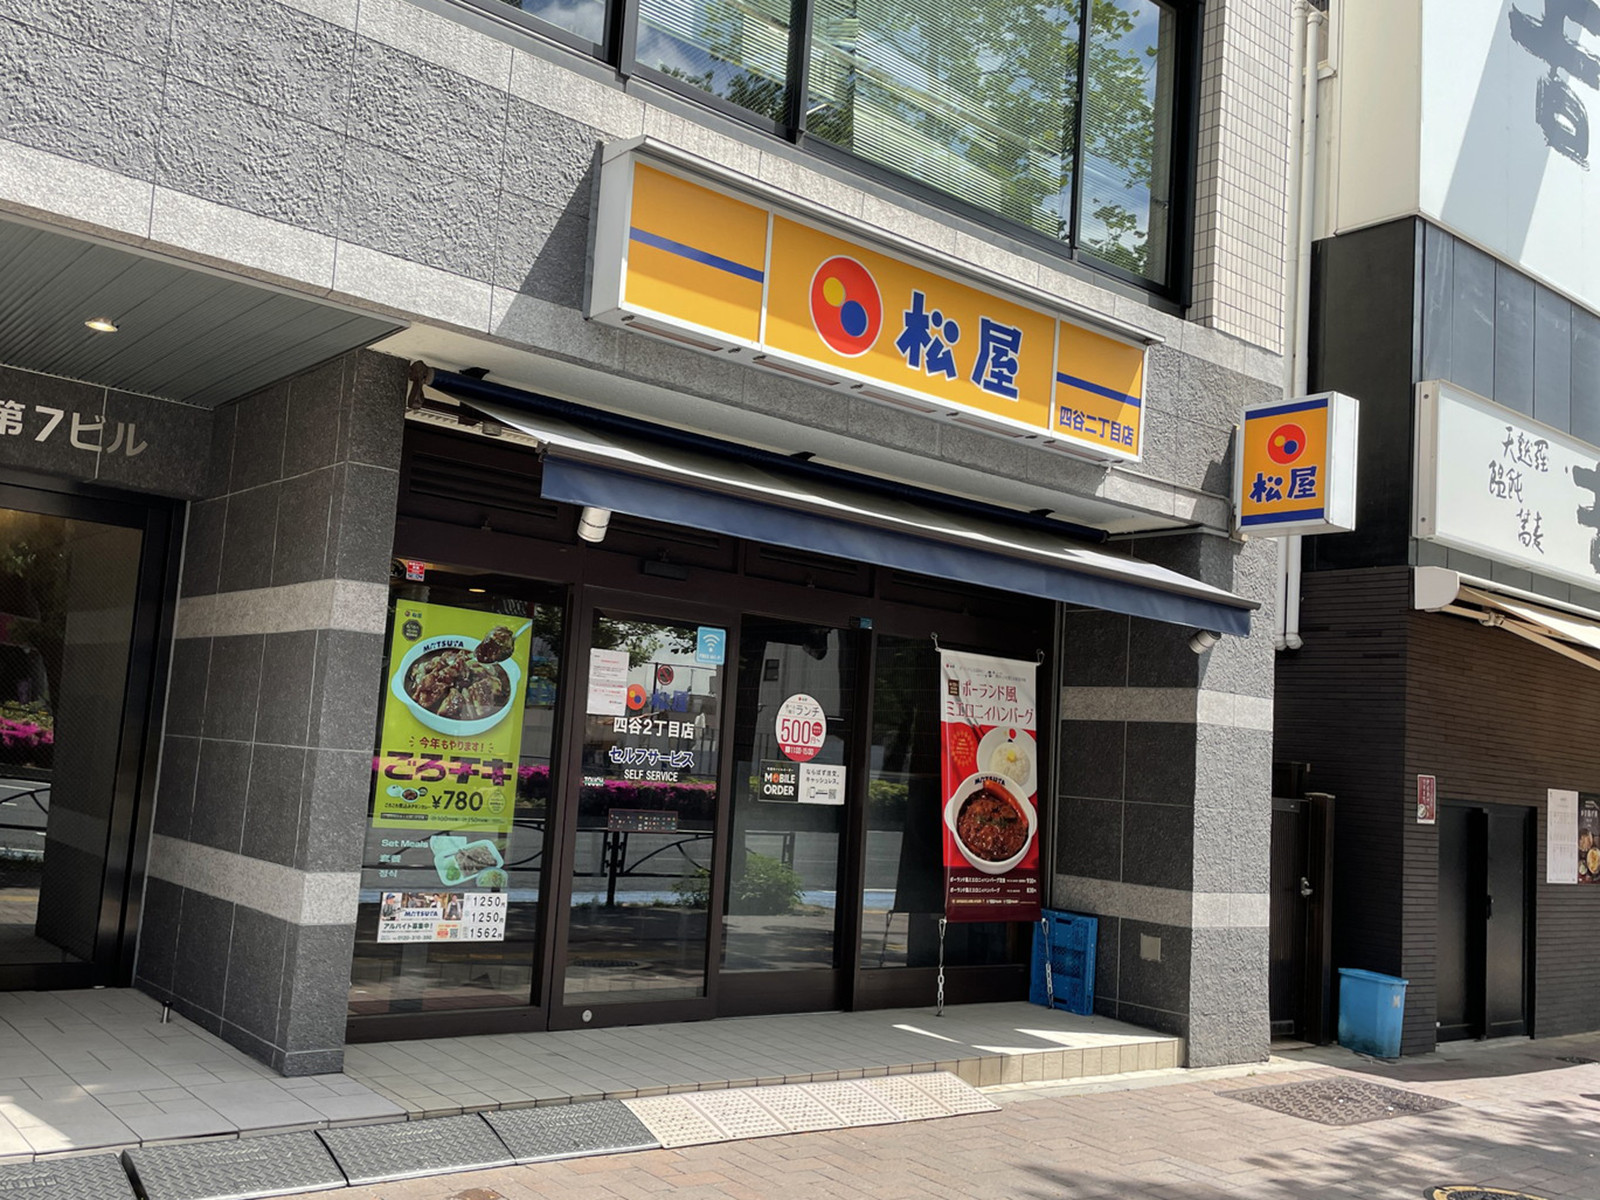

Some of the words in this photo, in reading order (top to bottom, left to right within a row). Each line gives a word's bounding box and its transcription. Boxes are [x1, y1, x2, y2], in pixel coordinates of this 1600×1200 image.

[895, 288, 1023, 402] 松屋
[0, 400, 148, 457] 第7ビル
[1060, 405, 1134, 447] 四谷二丁目店
[1250, 465, 1318, 503] 松屋
[963, 680, 1018, 703] ポーランド風
[796, 704, 820, 717] ランチ
[613, 716, 695, 740] 四谷2丁目店
[419, 736, 484, 753] 今年もやります！
[608, 745, 695, 768] セルフサービス
[384, 750, 513, 787] ごろチキ
[624, 768, 644, 780] SELF
[645, 770, 678, 782] SERVICE
[764, 772, 796, 784] MOBILE
[431, 790, 484, 812] ¥780
[763, 784, 795, 797] ORDER
[381, 839, 399, 848] Set
[400, 839, 429, 849] Meals
